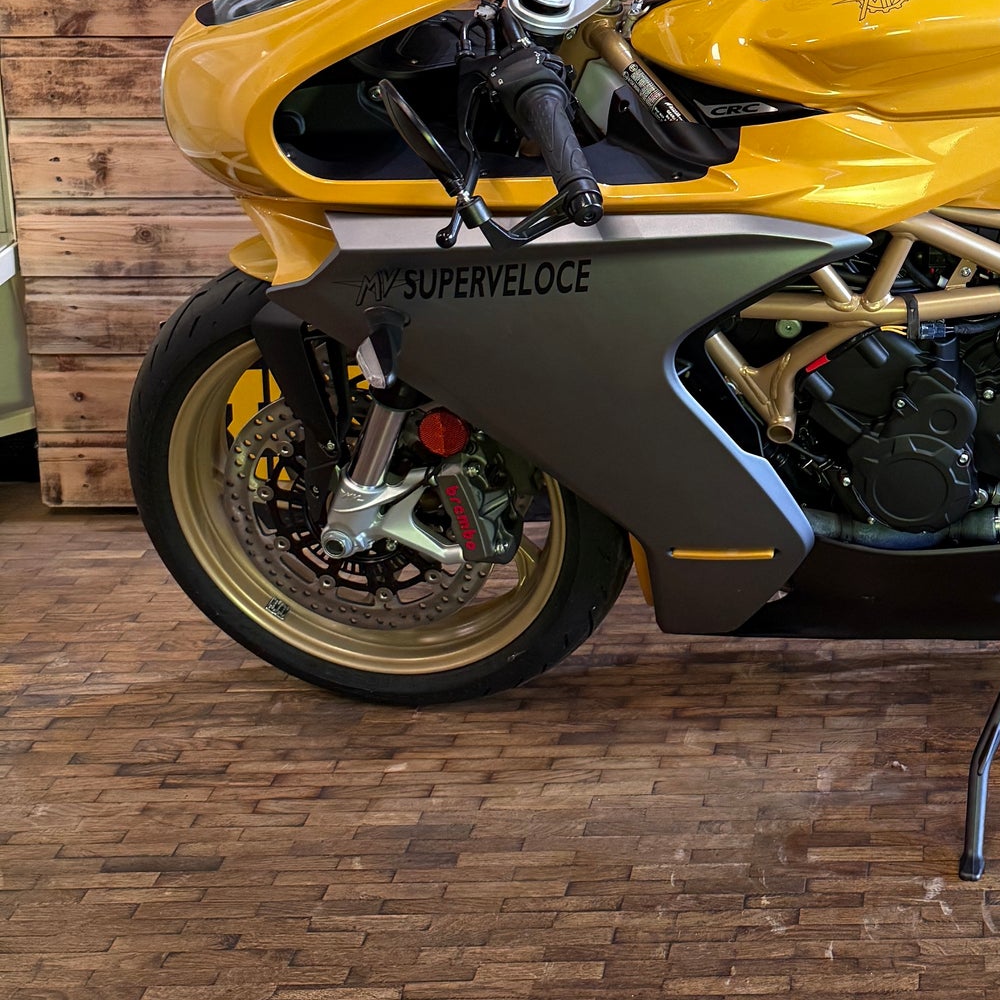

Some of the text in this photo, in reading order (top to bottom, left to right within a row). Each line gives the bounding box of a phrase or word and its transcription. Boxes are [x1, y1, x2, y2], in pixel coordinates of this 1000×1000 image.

[710, 103, 760, 116] CRC
[403, 259, 592, 300] SUPERVELOCE
[445, 484, 476, 551] brembo
